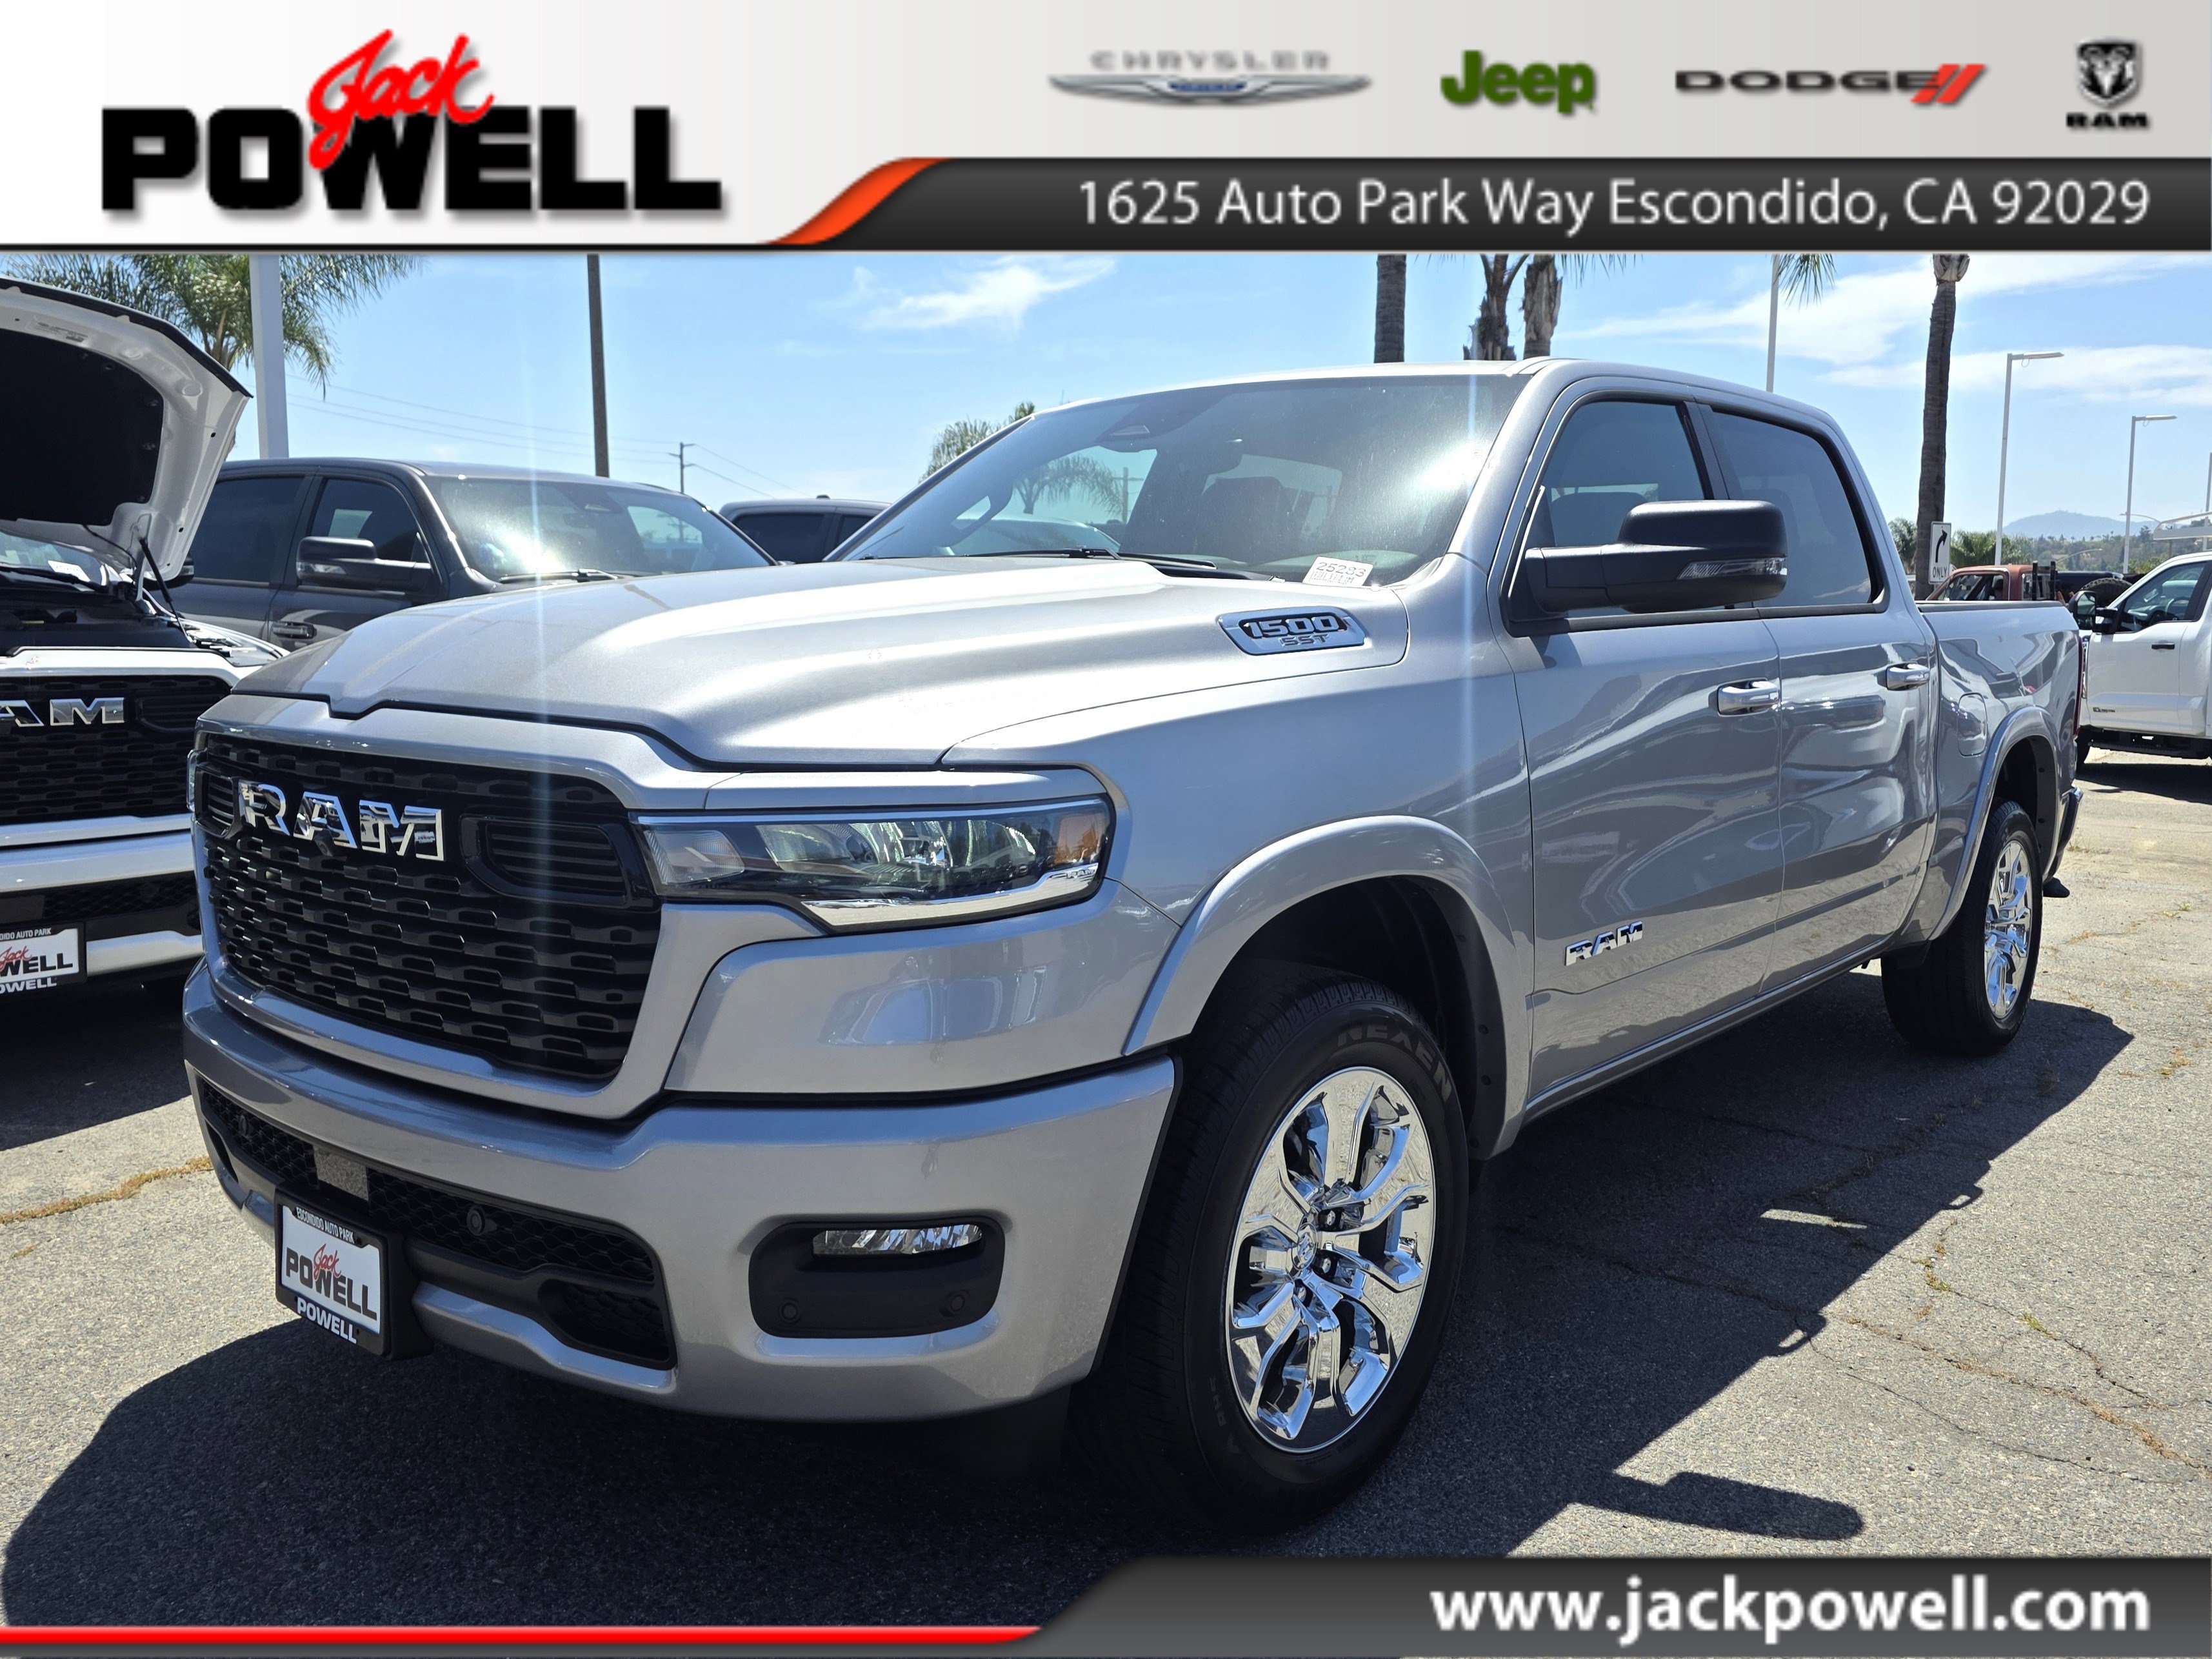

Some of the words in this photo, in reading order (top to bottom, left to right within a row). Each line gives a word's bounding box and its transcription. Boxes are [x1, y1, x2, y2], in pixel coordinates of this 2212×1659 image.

[1933, 567, 1948, 578] ONLY
[1242, 614, 1339, 639] 1500
[1277, 633, 1328, 646] SST
[238, 779, 445, 862] RAM
[16, 929, 34, 939] AUTO
[34, 928, 52, 936] PARK
[1564, 921, 1643, 967] RAM
[1337, 1024, 1452, 1103] NEXEN
[295, 1207, 324, 1231] ESCONDIDO
[324, 1220, 339, 1238] AUTO
[339, 1227, 355, 1244] PARK
[314, 1243, 341, 1280] Jack
[286, 1247, 377, 1321] POWELL
[297, 1297, 357, 1344] POWELL
